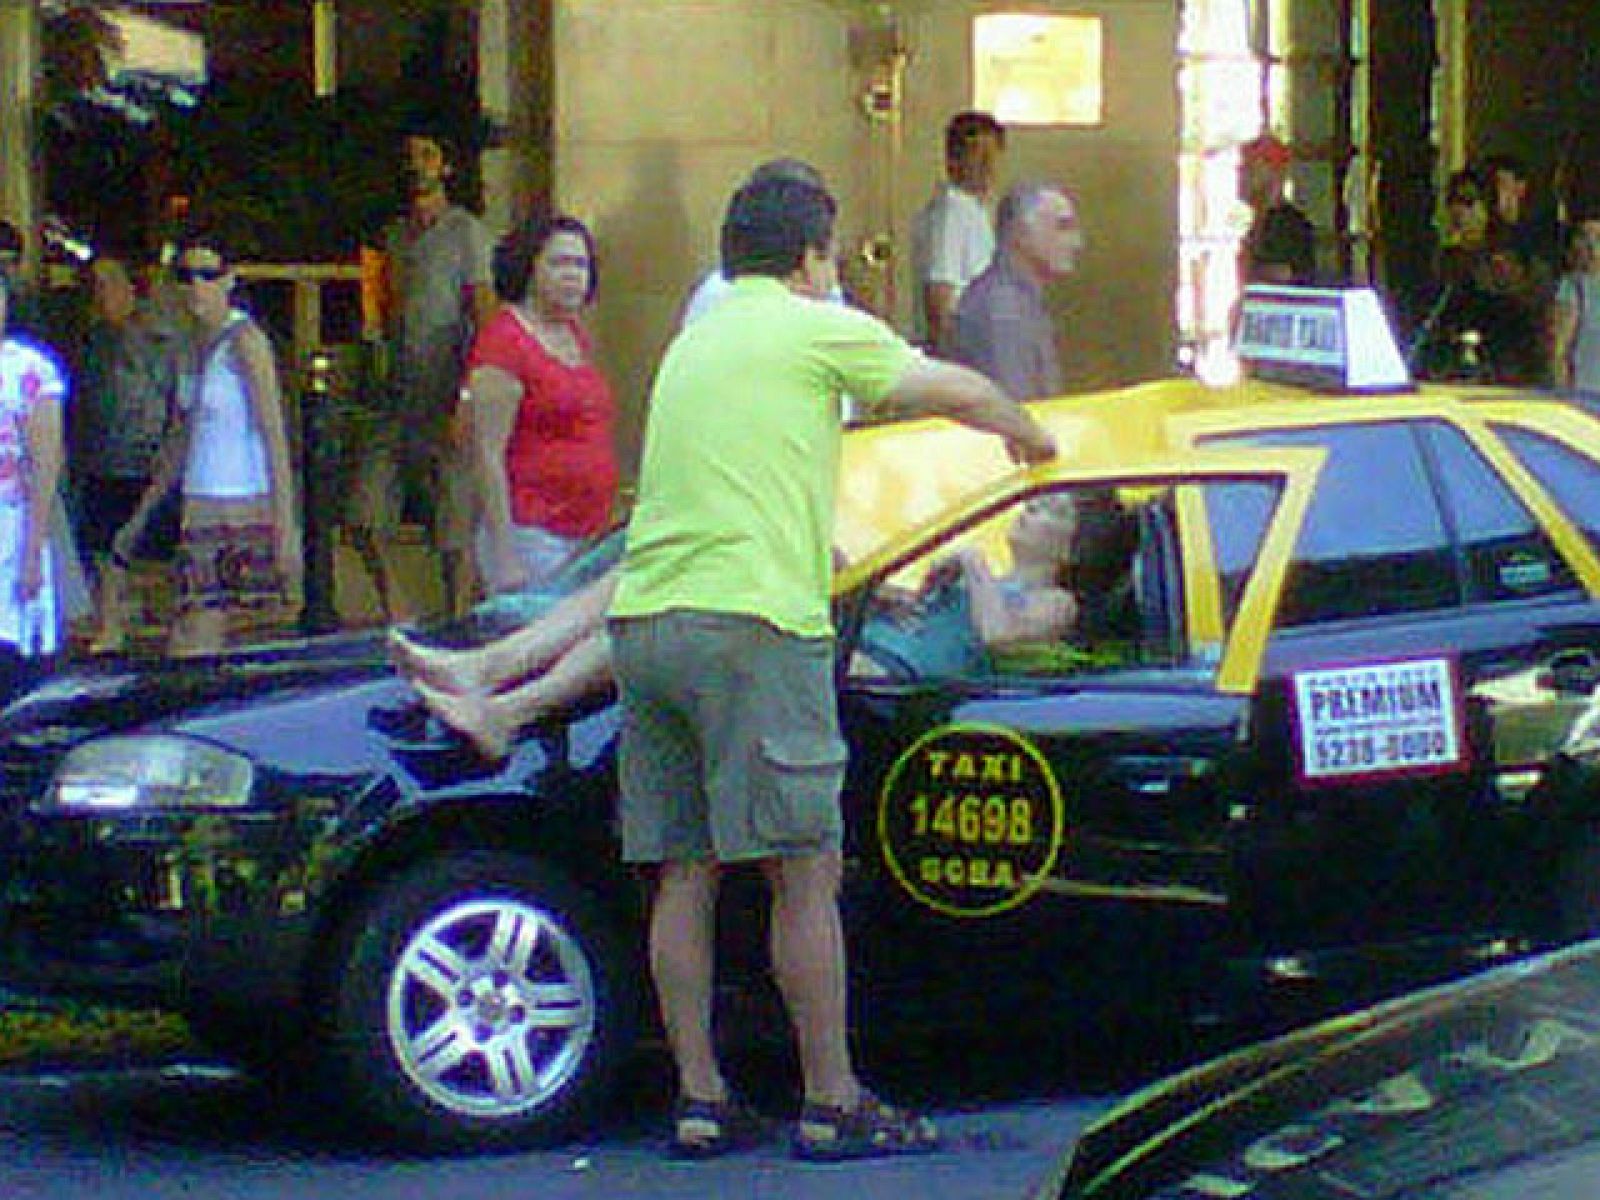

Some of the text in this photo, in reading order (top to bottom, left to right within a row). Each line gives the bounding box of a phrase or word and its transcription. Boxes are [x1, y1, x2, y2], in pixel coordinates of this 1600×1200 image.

[1311, 681, 1442, 720] PREMIUM
[927, 751, 1022, 781] TAXI
[910, 795, 1031, 843] 14698
